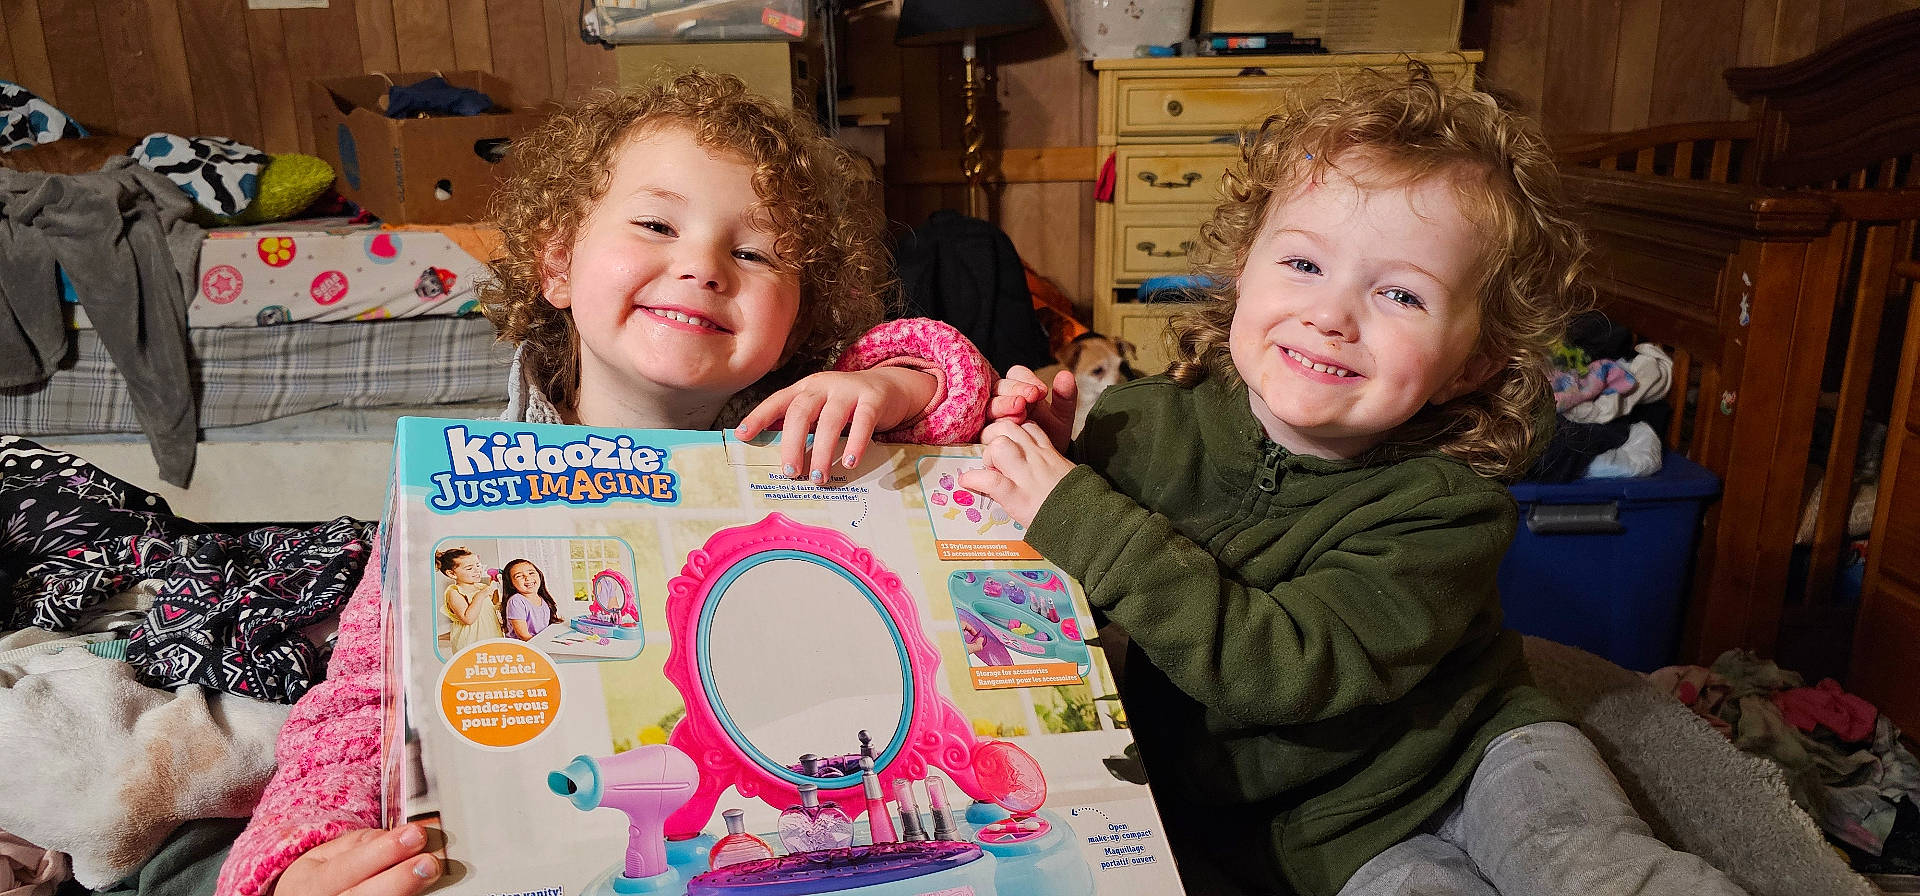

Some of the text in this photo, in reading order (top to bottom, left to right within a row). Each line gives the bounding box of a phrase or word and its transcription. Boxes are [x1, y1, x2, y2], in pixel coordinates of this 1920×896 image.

[433, 469, 673, 507] JUST IMAGINE
[851, 485, 860, 493] de
[765, 493, 802, 501] maquiller
[950, 543, 972, 551] Styling
[476, 652, 525, 664] Have a
[465, 662, 536, 679] play date!
[975, 667, 1048, 678] Storage for accessories
[978, 678, 1015, 686] Rangement
[1016, 677, 1032, 685] pour
[1042, 674, 1077, 683] accessoires
[456, 688, 547, 703] Organise un
[456, 702, 548, 715] rendez-vous
[461, 711, 545, 731] pour jouer!
[1108, 823, 1128, 832] Open
[1087, 829, 1152, 843] make-up compact
[1104, 844, 1145, 856] Maquillage
[1100, 854, 1156, 870] portatif ouvert
